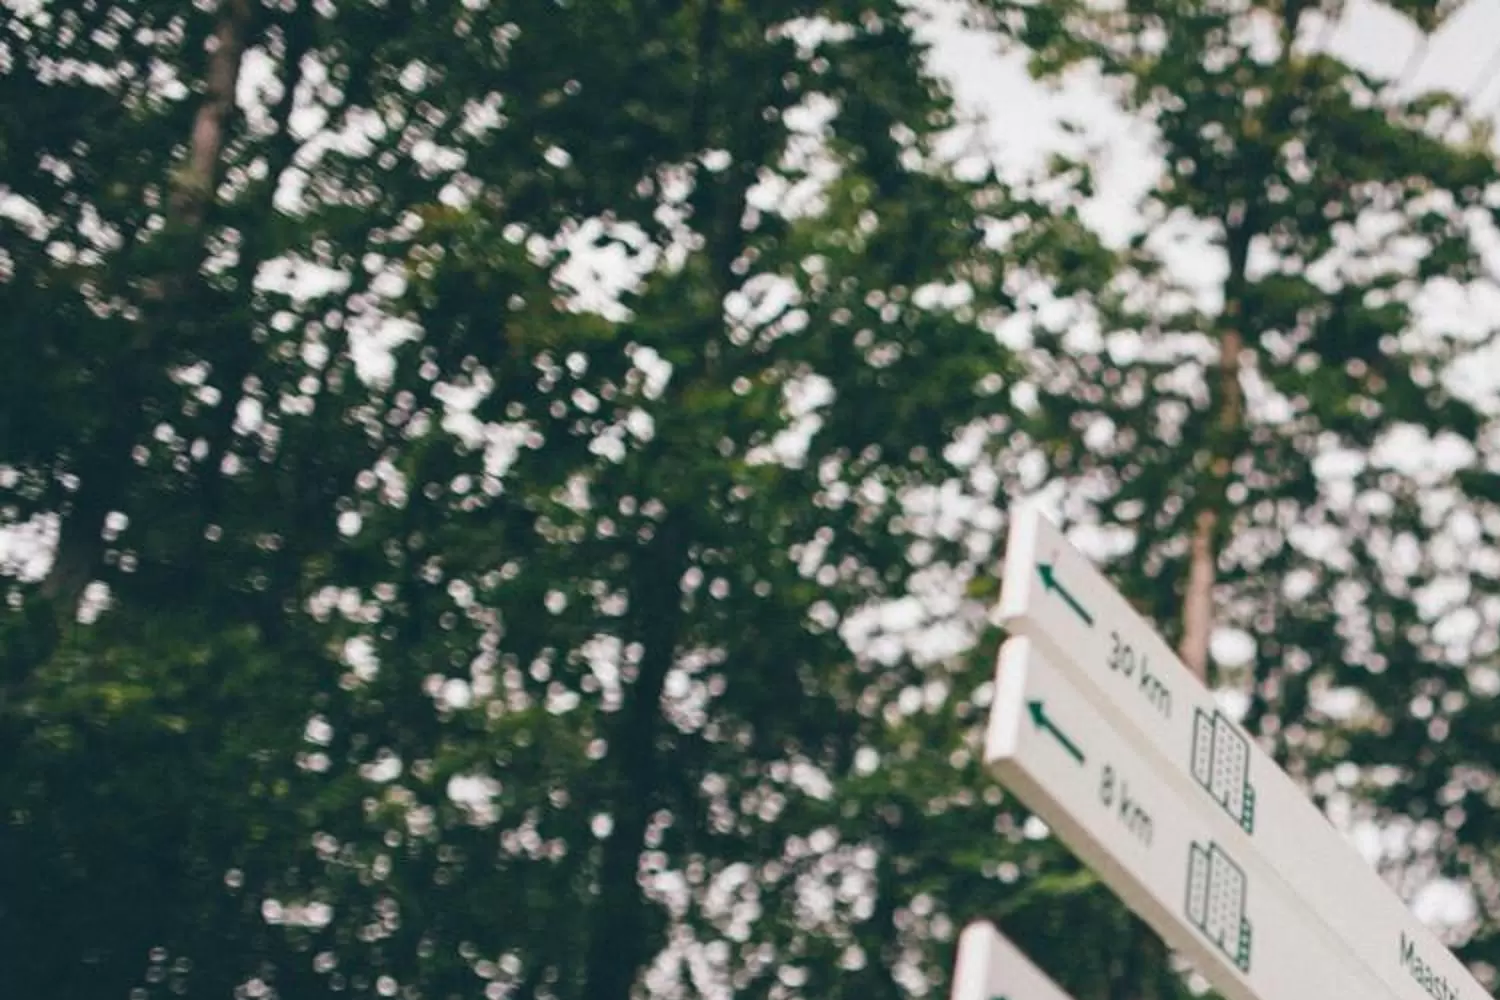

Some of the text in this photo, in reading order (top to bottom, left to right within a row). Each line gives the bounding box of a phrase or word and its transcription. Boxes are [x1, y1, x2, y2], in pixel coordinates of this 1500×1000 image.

[1139, 652, 1172, 719] km
[1101, 762, 1153, 848] 8 km
